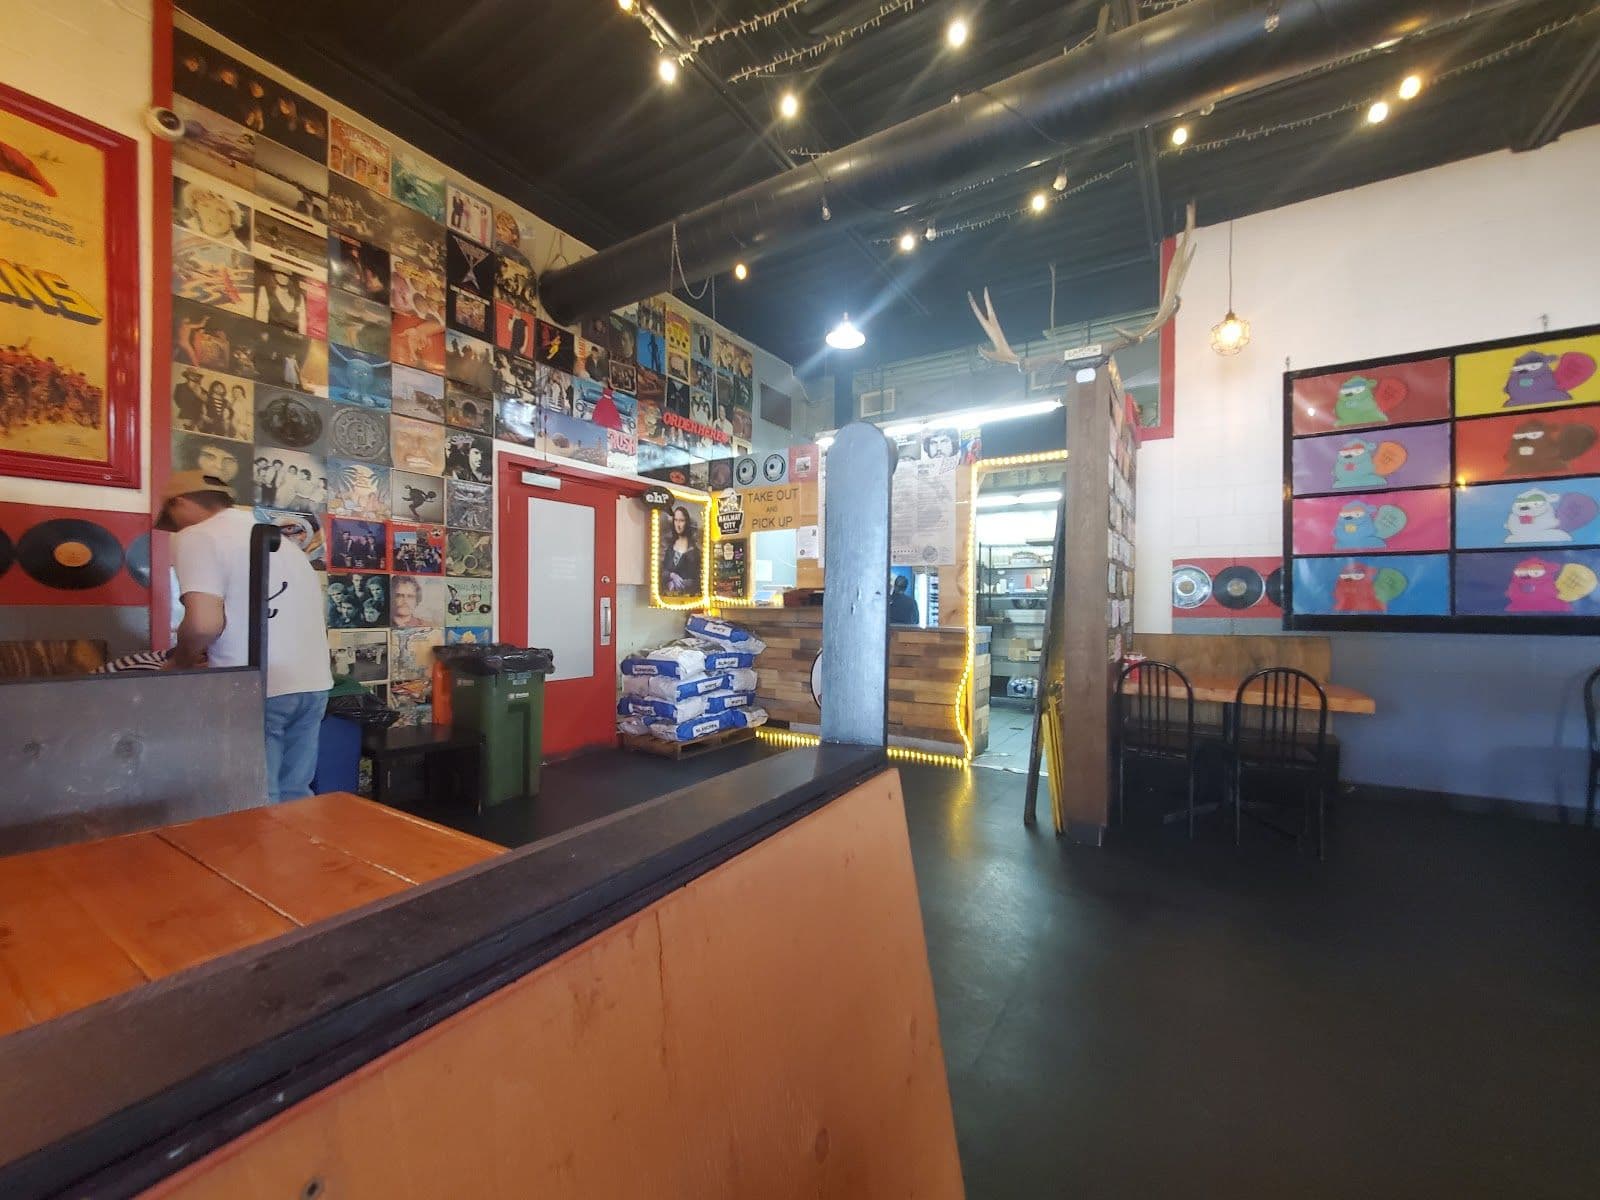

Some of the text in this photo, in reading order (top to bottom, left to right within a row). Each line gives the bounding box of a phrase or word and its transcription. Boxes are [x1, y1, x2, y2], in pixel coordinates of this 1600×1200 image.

[607, 430, 637, 456] RUSH
[645, 491, 669, 505] eh?
[747, 488, 799, 503] TAKE OUT
[766, 505, 778, 513] AND
[718, 513, 741, 523] RAILWAY
[751, 516, 793, 529] PICK UP
[723, 521, 736, 530] CITY
